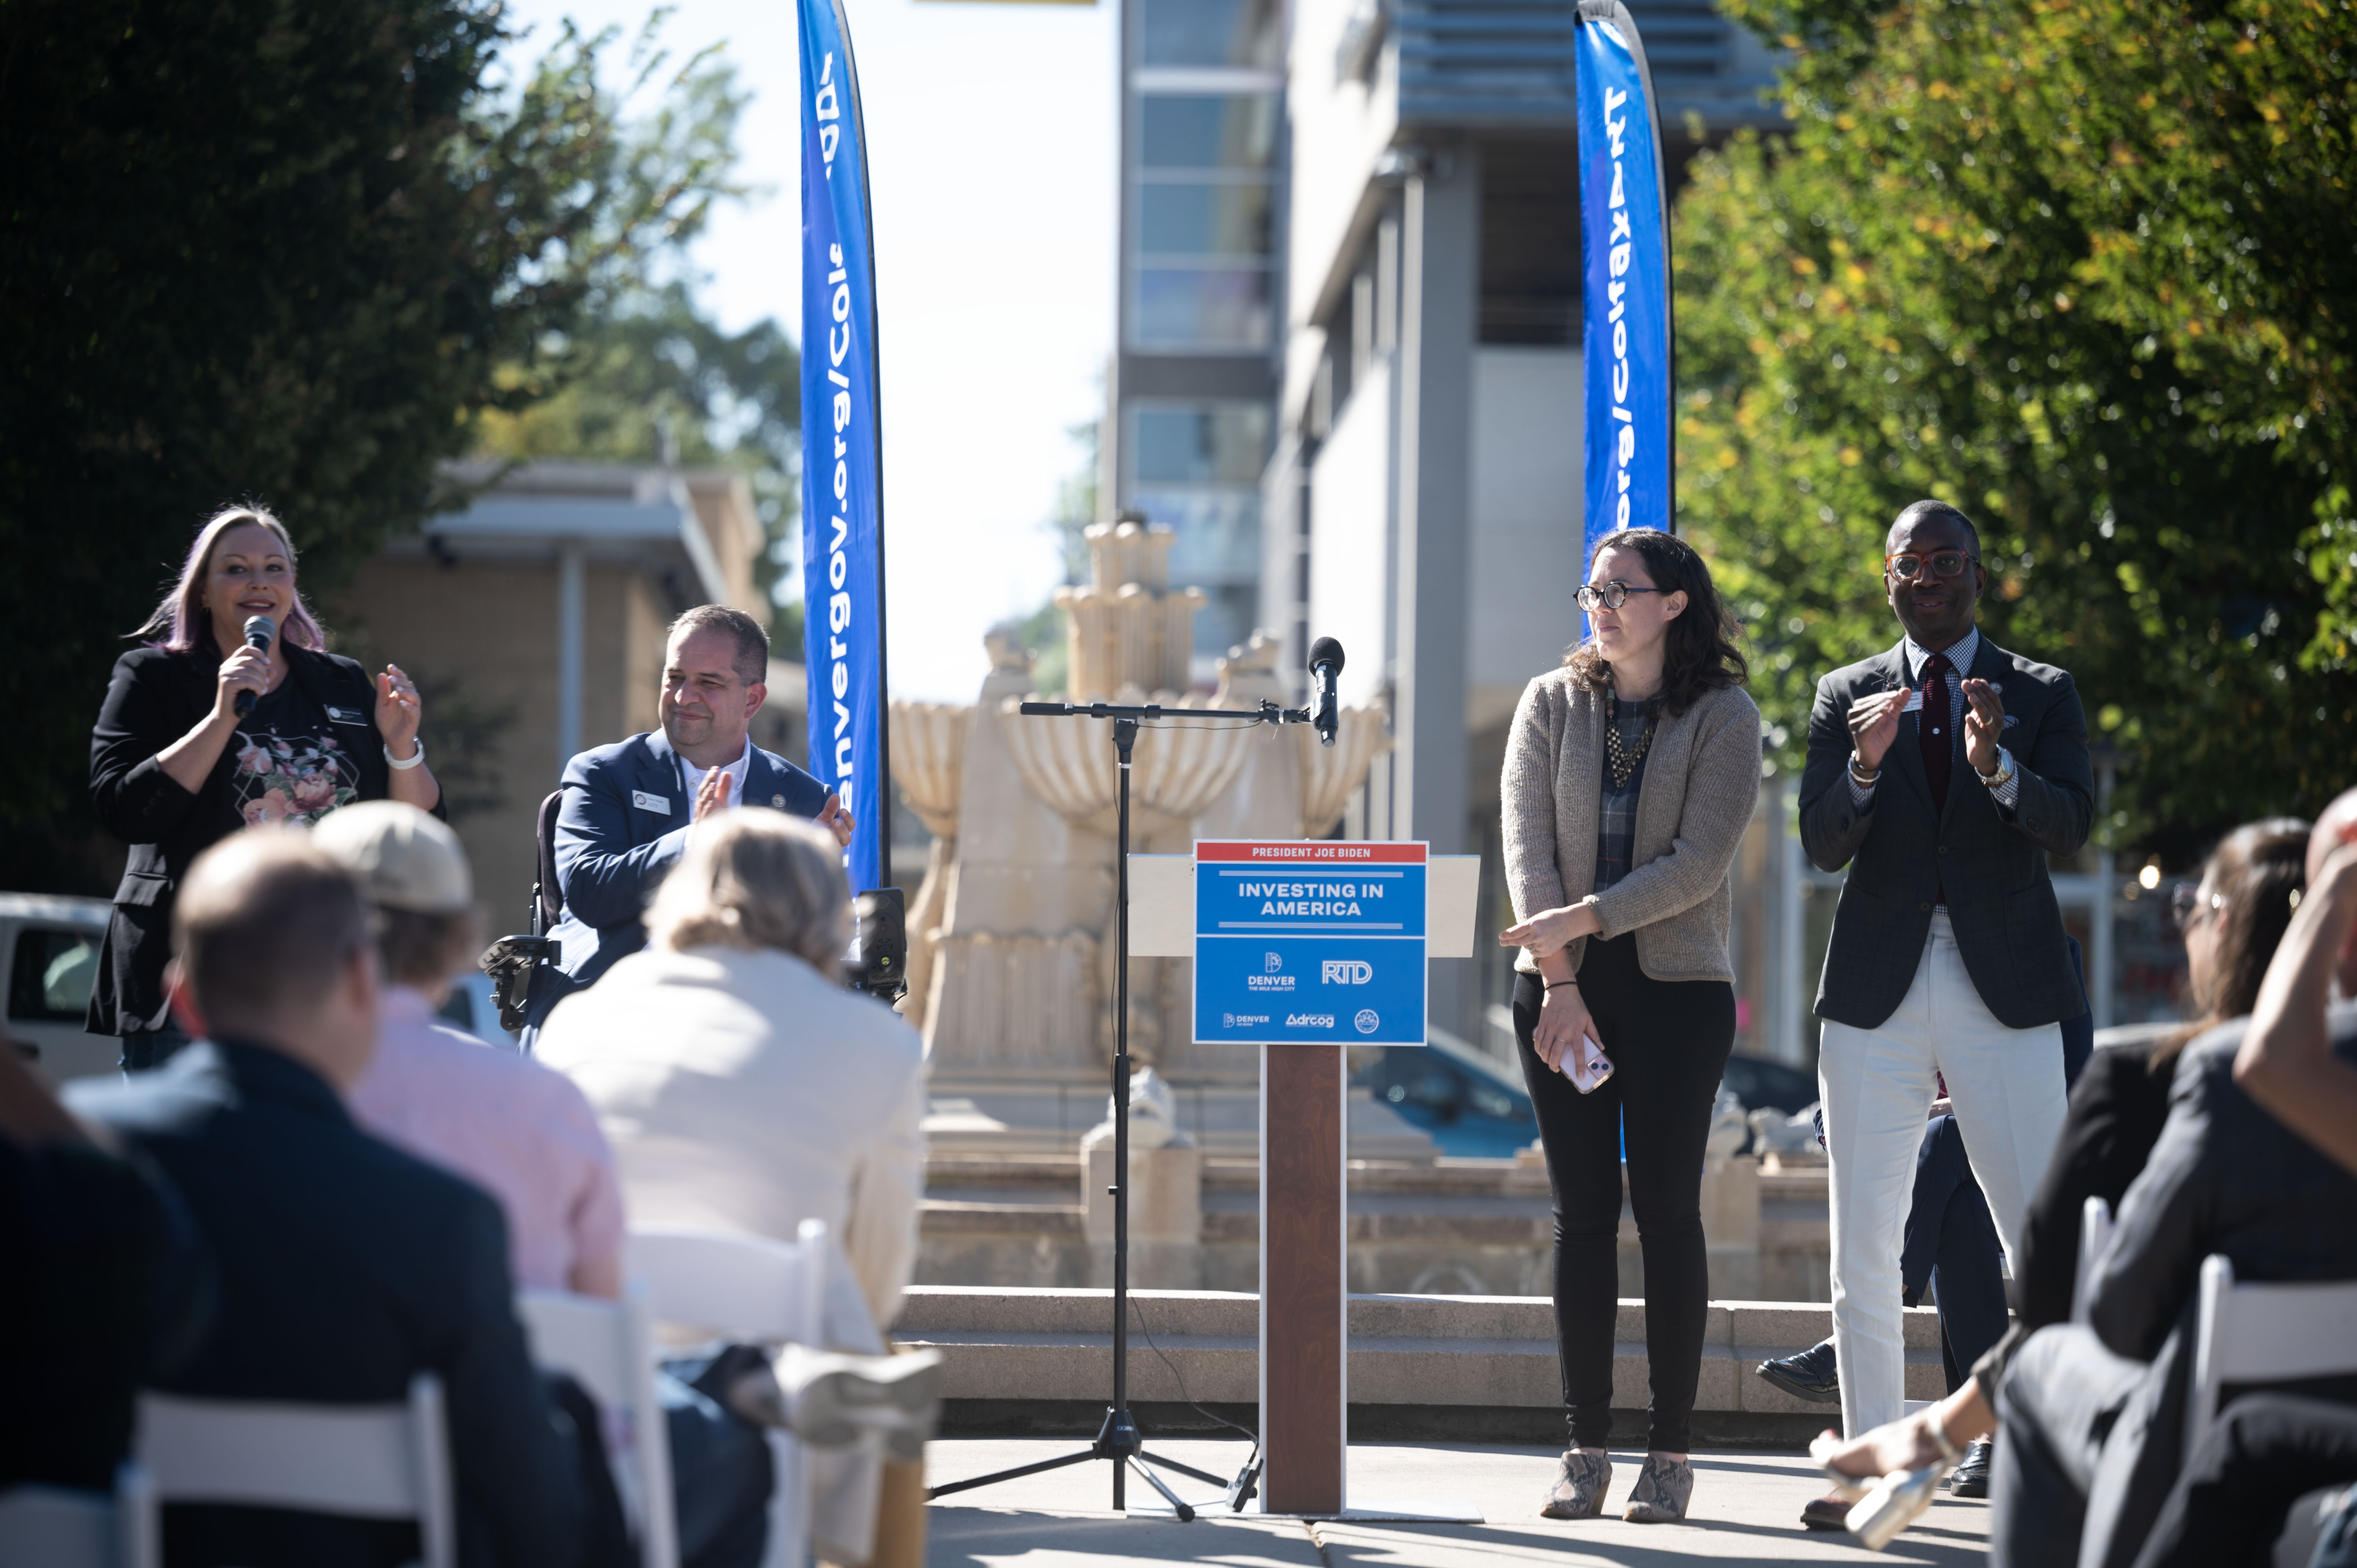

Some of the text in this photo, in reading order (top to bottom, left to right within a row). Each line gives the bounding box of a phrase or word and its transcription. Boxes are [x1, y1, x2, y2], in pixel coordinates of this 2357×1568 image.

[1253, 847, 1370, 858] PRESIDENT JOE BIDEN
[1239, 883, 1383, 898] INVESTING IN
[1261, 901, 1361, 916] AMERICA
[1322, 960, 1373, 984] RTD
[1248, 976, 1295, 985] DENVER
